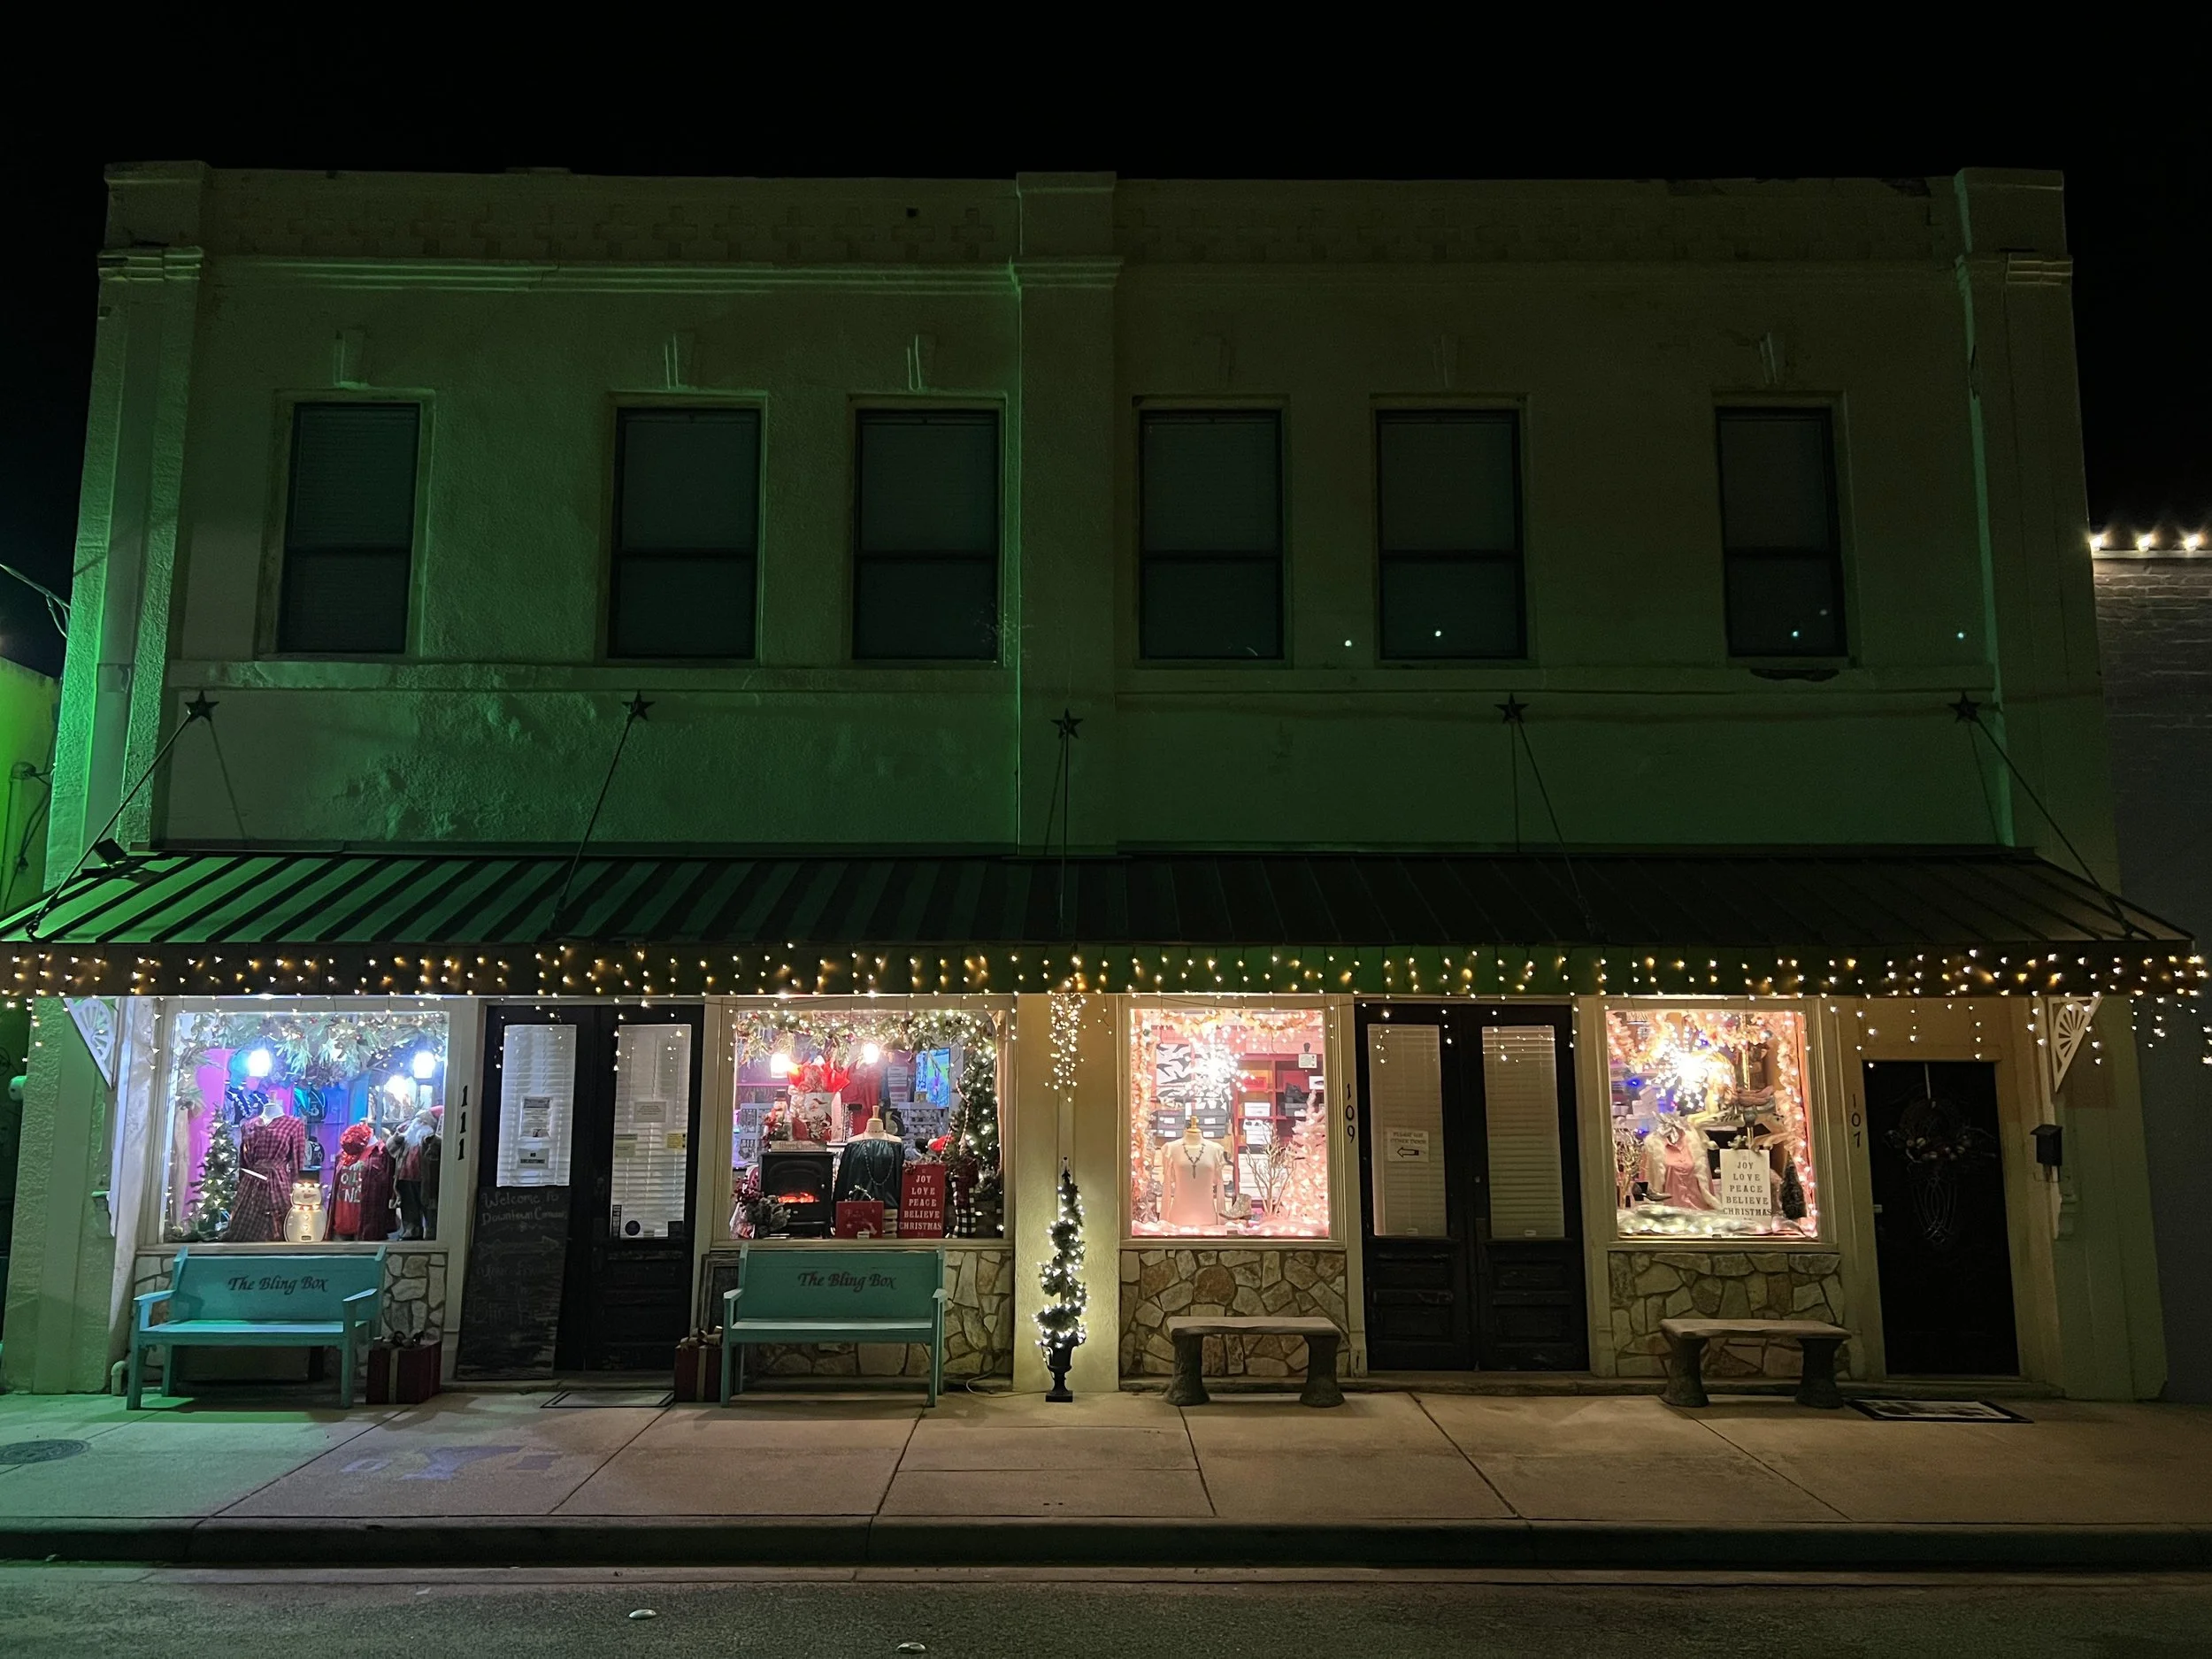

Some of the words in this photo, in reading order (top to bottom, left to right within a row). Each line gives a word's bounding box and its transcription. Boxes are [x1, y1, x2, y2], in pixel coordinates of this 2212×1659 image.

[1345, 1083, 1355, 1143] 109
[457, 1085, 468, 1161] 111
[1851, 1094, 1862, 1148] 107
[911, 1187, 935, 1195] LOVE
[481, 1191, 541, 1210] Welcome
[909, 1198, 937, 1207] PEACE
[1726, 1196, 1769, 1205] BELIEVE
[481, 1210, 533, 1225] Downtown
[903, 1210, 941, 1218] BELIEVE
[1723, 1208, 1772, 1217] CHRISTMAS
[899, 1222, 942, 1231] CHRISTMAS
[227, 1274, 256, 1291] The
[258, 1275, 298, 1295] Bling
[301, 1276, 330, 1292] Box
[797, 1271, 825, 1286] The
[828, 1271, 867, 1293] Bling
[869, 1273, 897, 1290] Box
